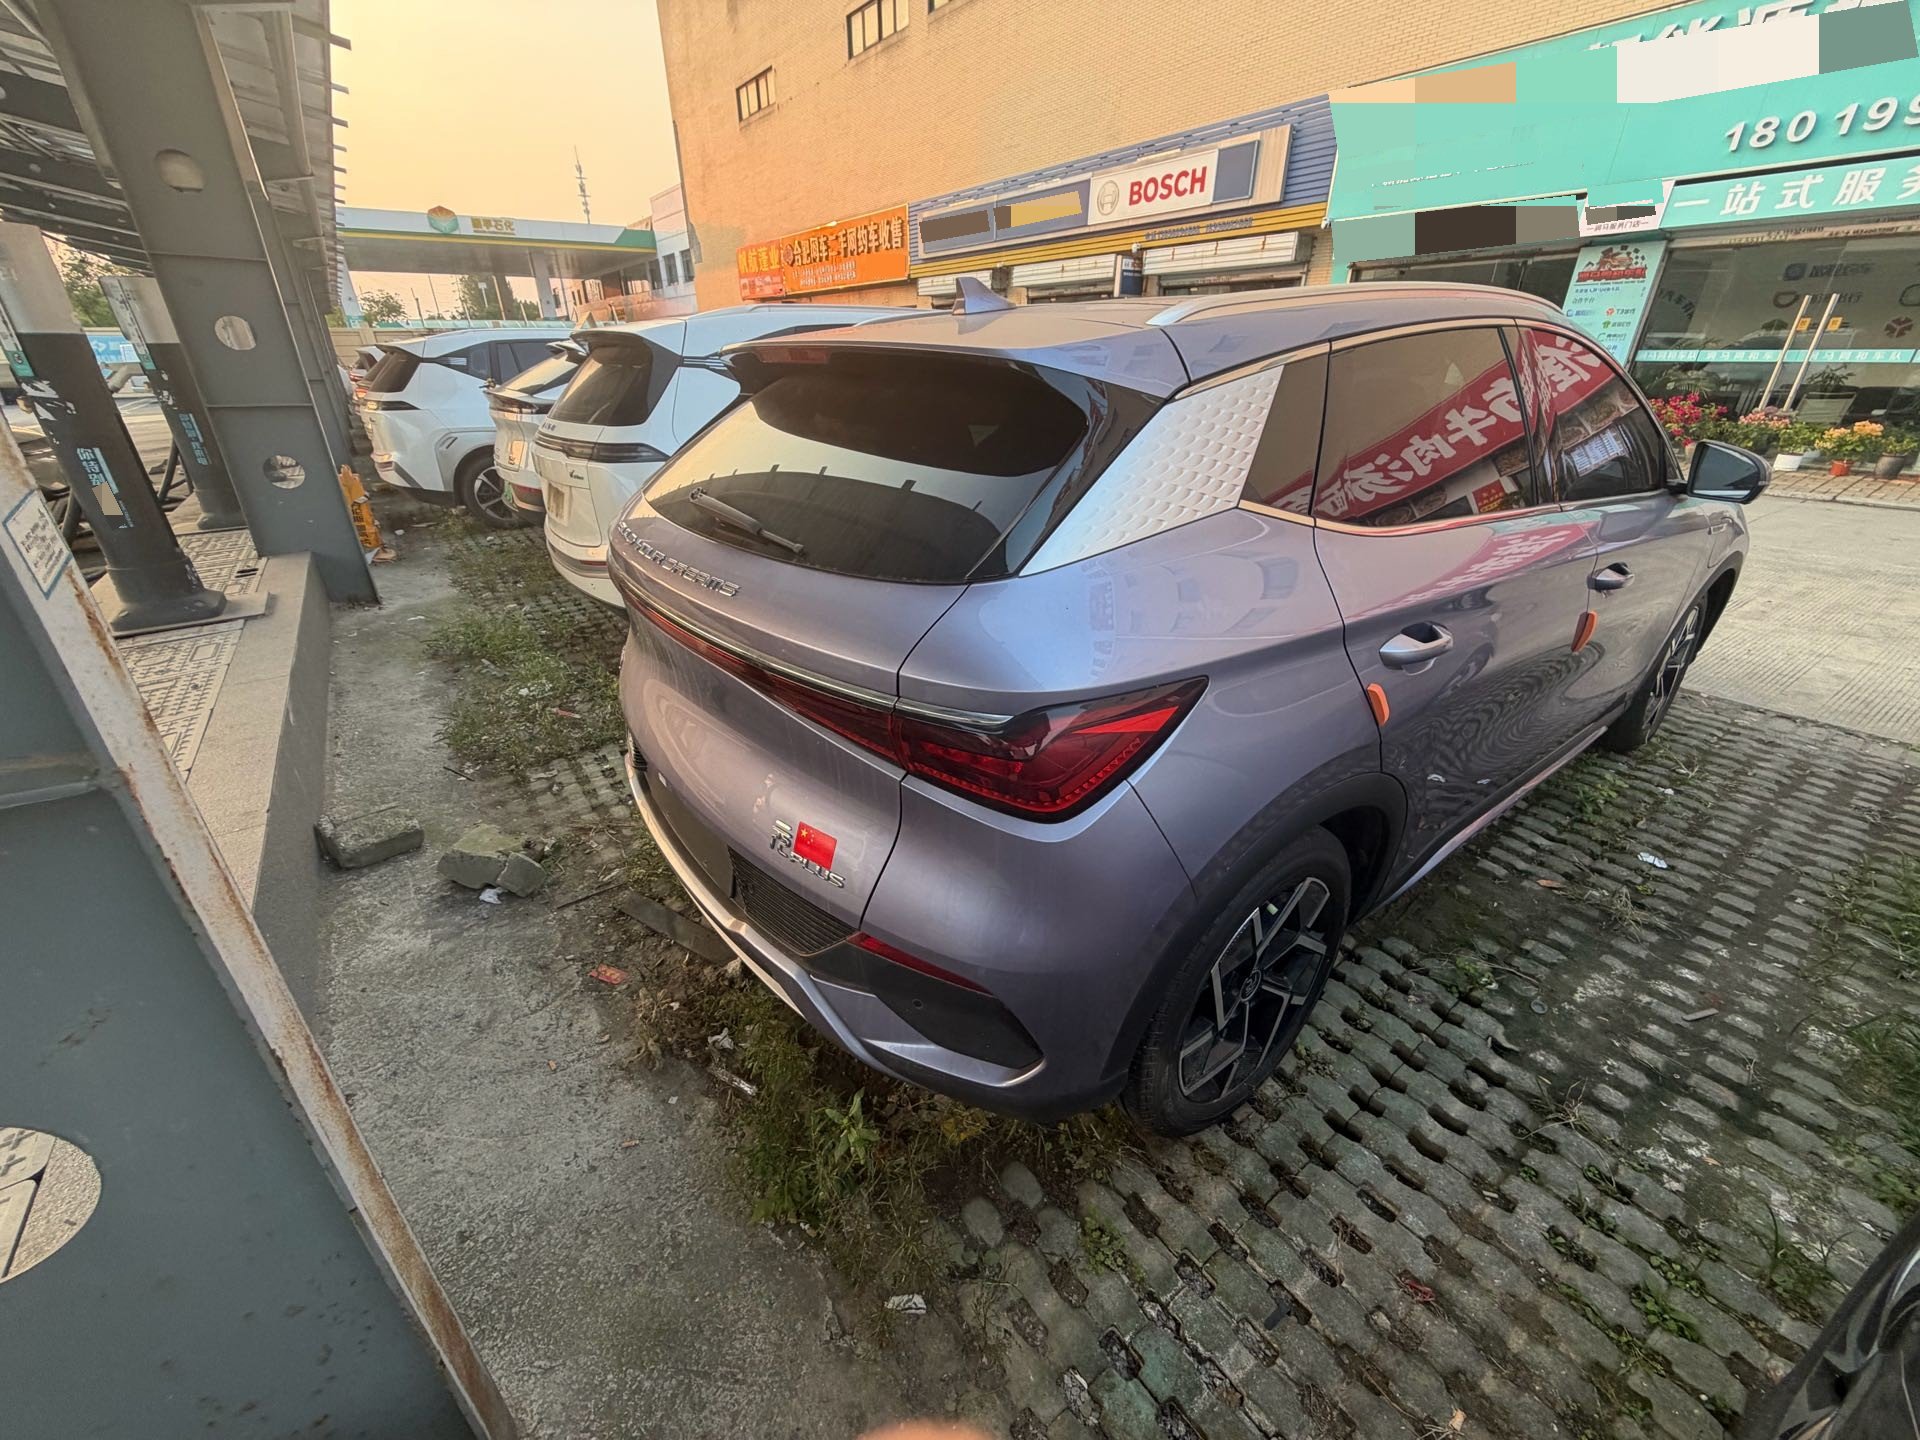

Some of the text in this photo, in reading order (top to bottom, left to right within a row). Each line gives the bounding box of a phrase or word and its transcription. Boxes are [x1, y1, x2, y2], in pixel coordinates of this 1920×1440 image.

[1725, 110, 1817, 152] 180
[1129, 166, 1208, 206] BOSCH
[662, 557, 741, 597] DREAMS
